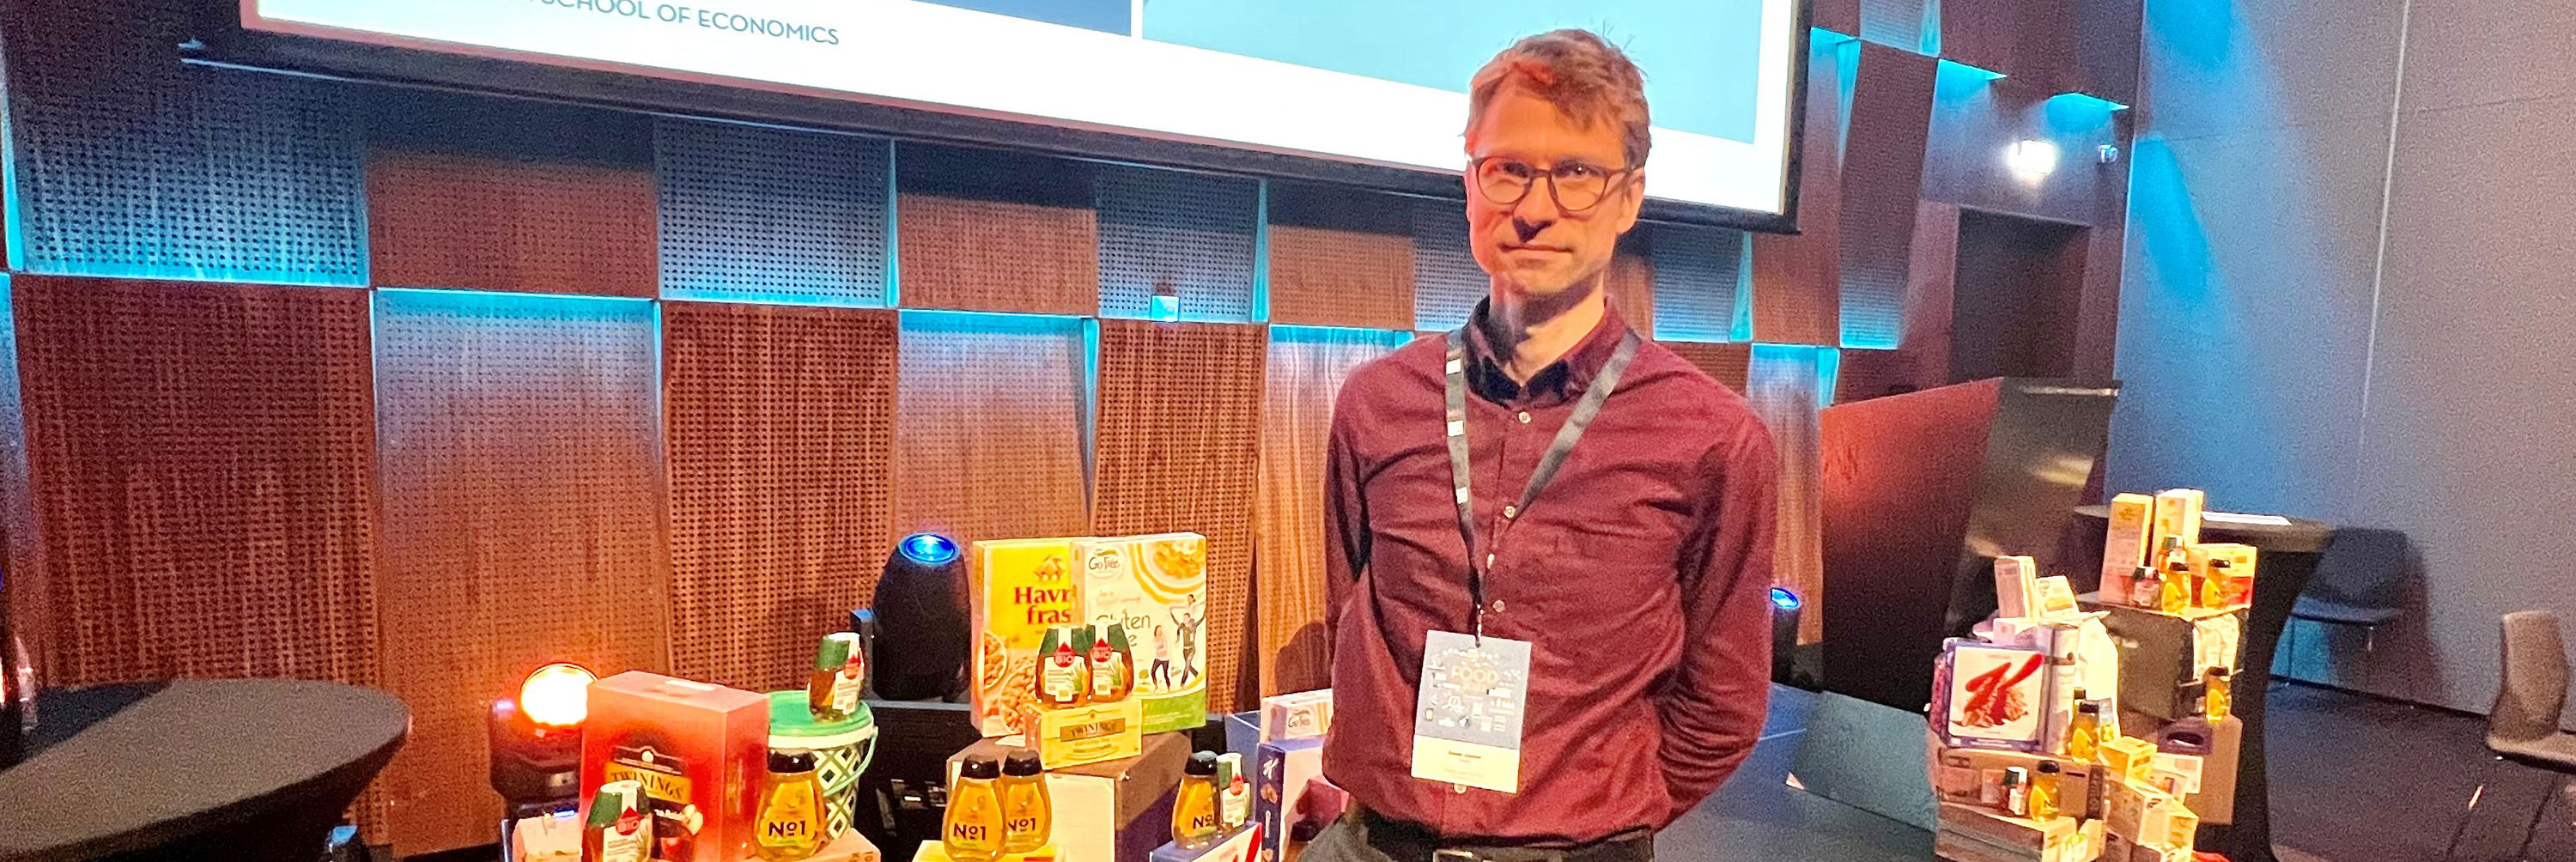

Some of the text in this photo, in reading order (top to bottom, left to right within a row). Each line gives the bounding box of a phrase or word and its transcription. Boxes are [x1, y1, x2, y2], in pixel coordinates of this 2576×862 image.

[541, 0, 839, 45] HOOL OF ECONOMICS
[1027, 605, 1072, 625] fras
[1451, 665, 1499, 684] FOOD
